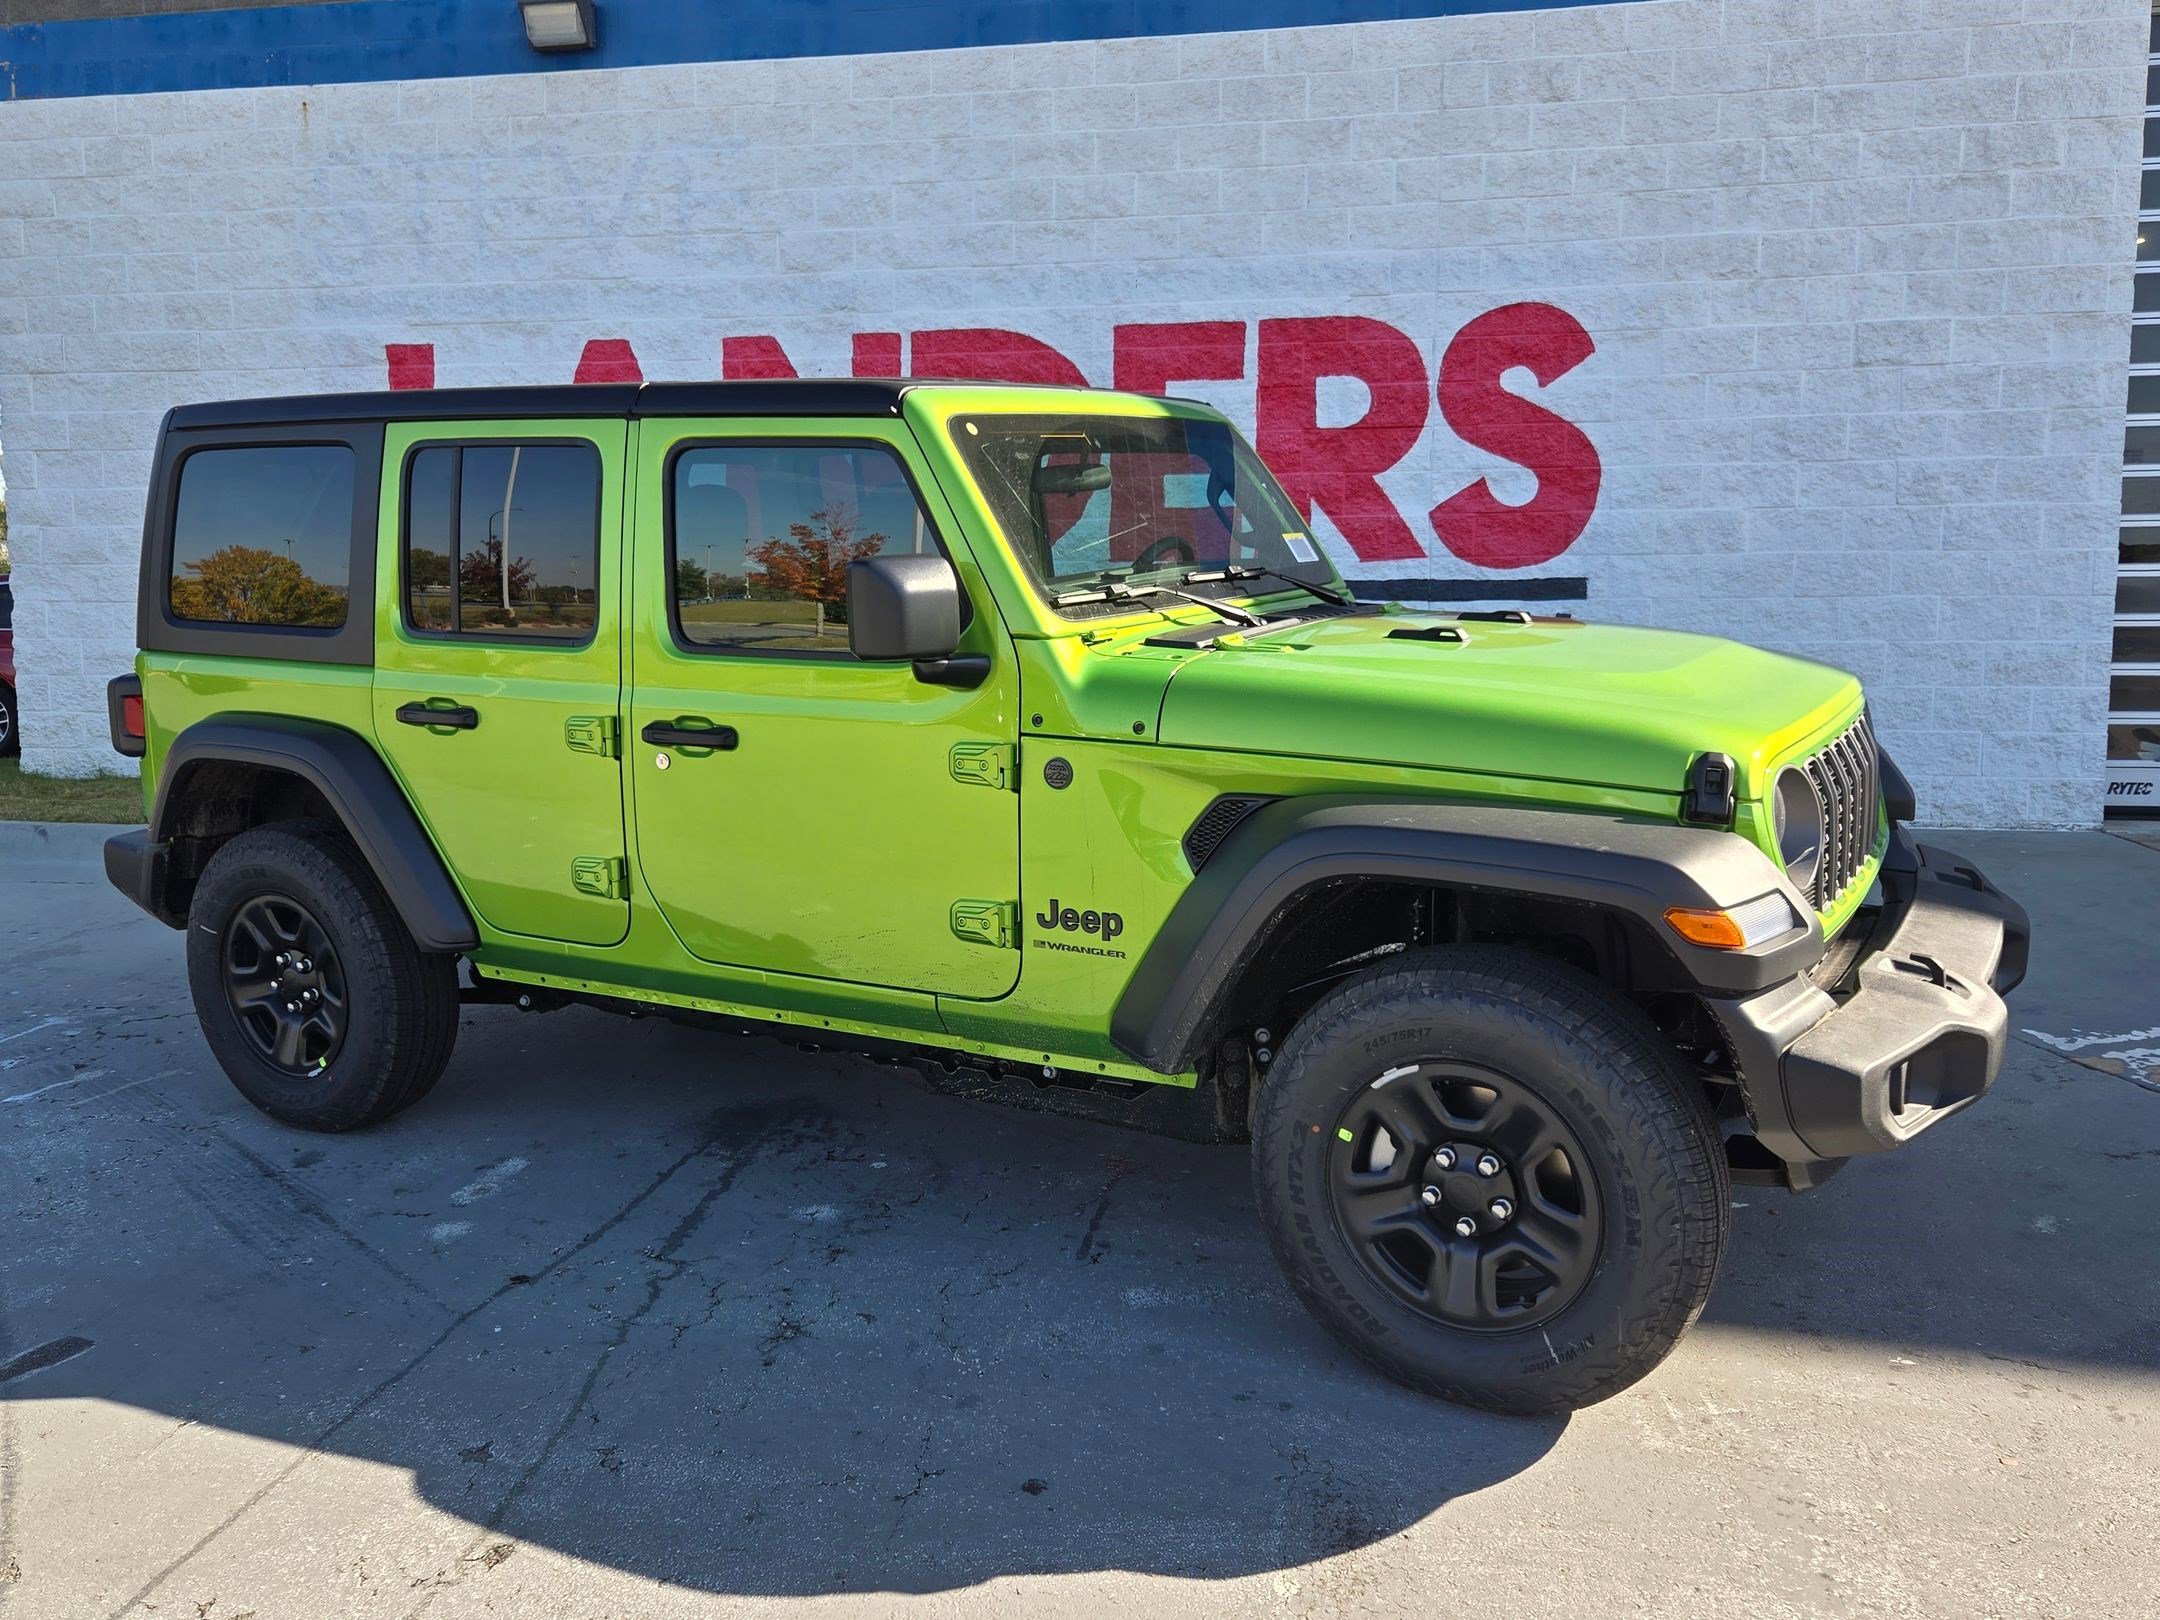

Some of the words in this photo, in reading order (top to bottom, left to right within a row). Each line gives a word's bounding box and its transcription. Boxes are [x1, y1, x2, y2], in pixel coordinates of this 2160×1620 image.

[386, 302, 1602, 570] DERS
[2106, 782, 2154, 795] RYTEC
[1036, 899, 1124, 942] Jeep
[1047, 941, 1127, 959] WRANGLER
[1363, 1027, 1433, 1053] 245/75R17
[1294, 1213, 1391, 1336] ROADIAN
